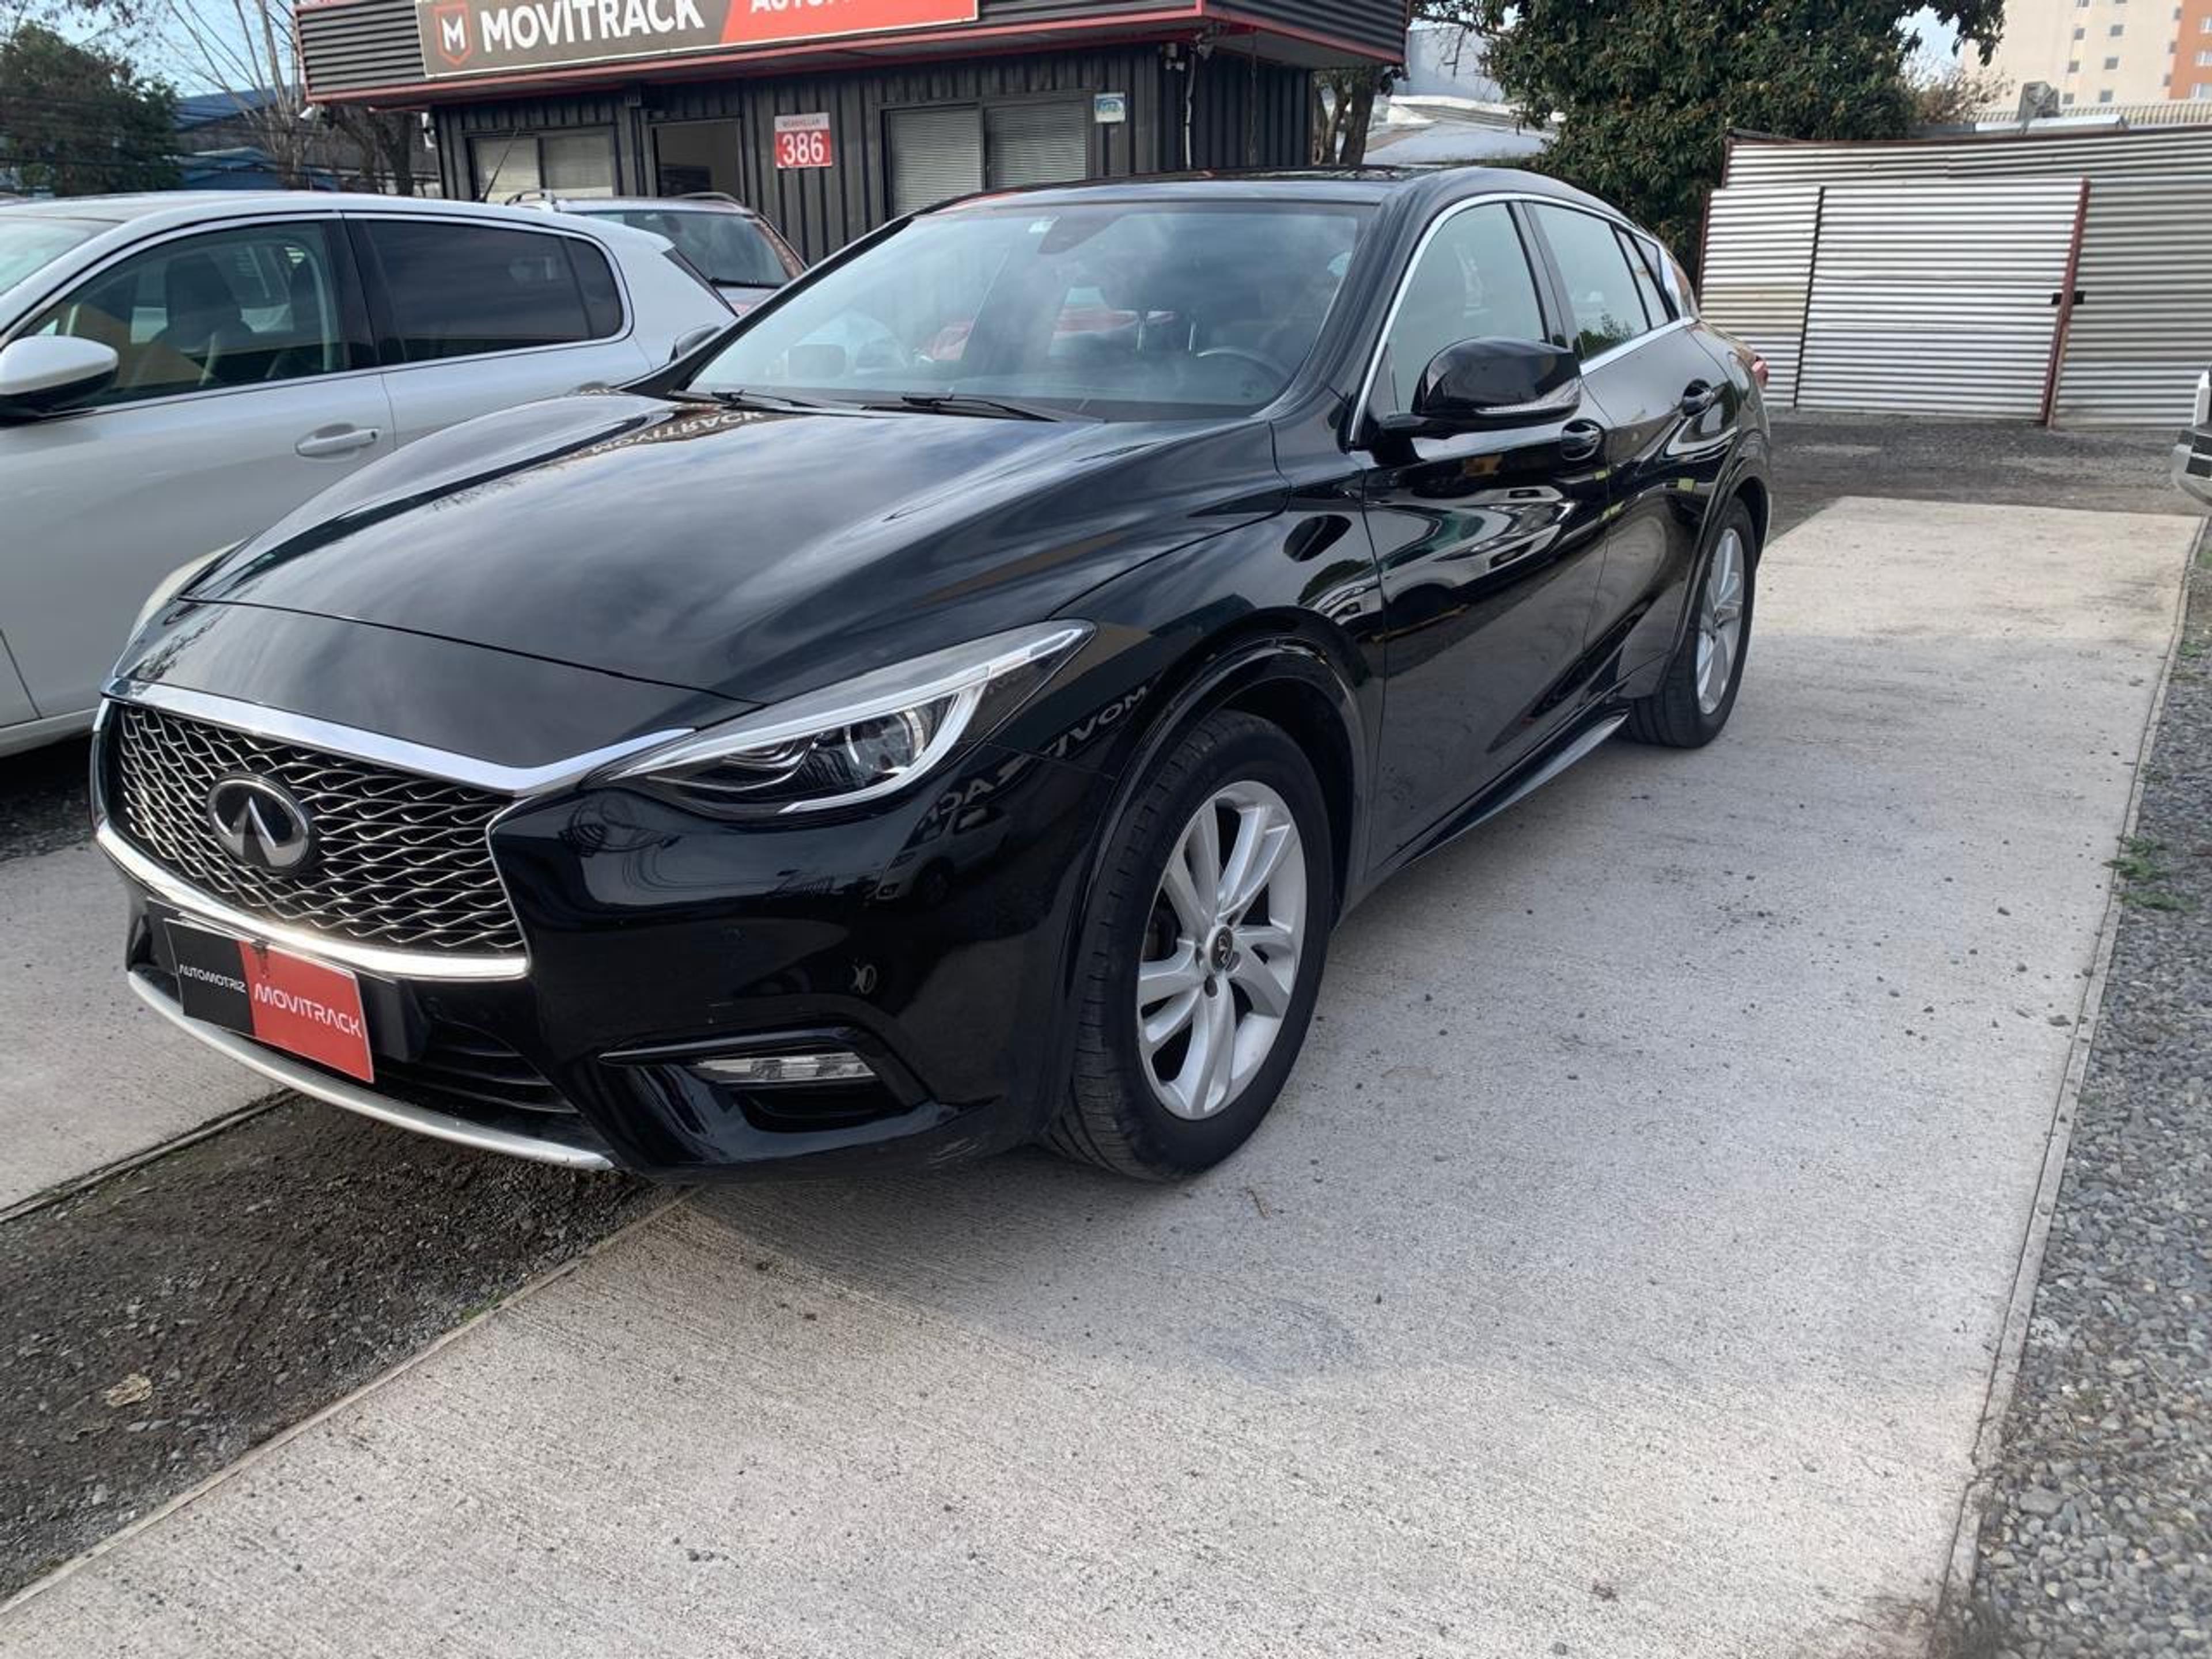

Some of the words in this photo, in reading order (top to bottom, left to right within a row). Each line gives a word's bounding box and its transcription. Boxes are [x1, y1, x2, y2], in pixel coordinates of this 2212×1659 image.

[441, 15, 465, 51] M
[480, 0, 704, 52] MOVITRACK
[782, 131, 824, 164] 386
[179, 964, 247, 993] AUTOMOTRIZ
[254, 983, 362, 1037] MOVITRACK
